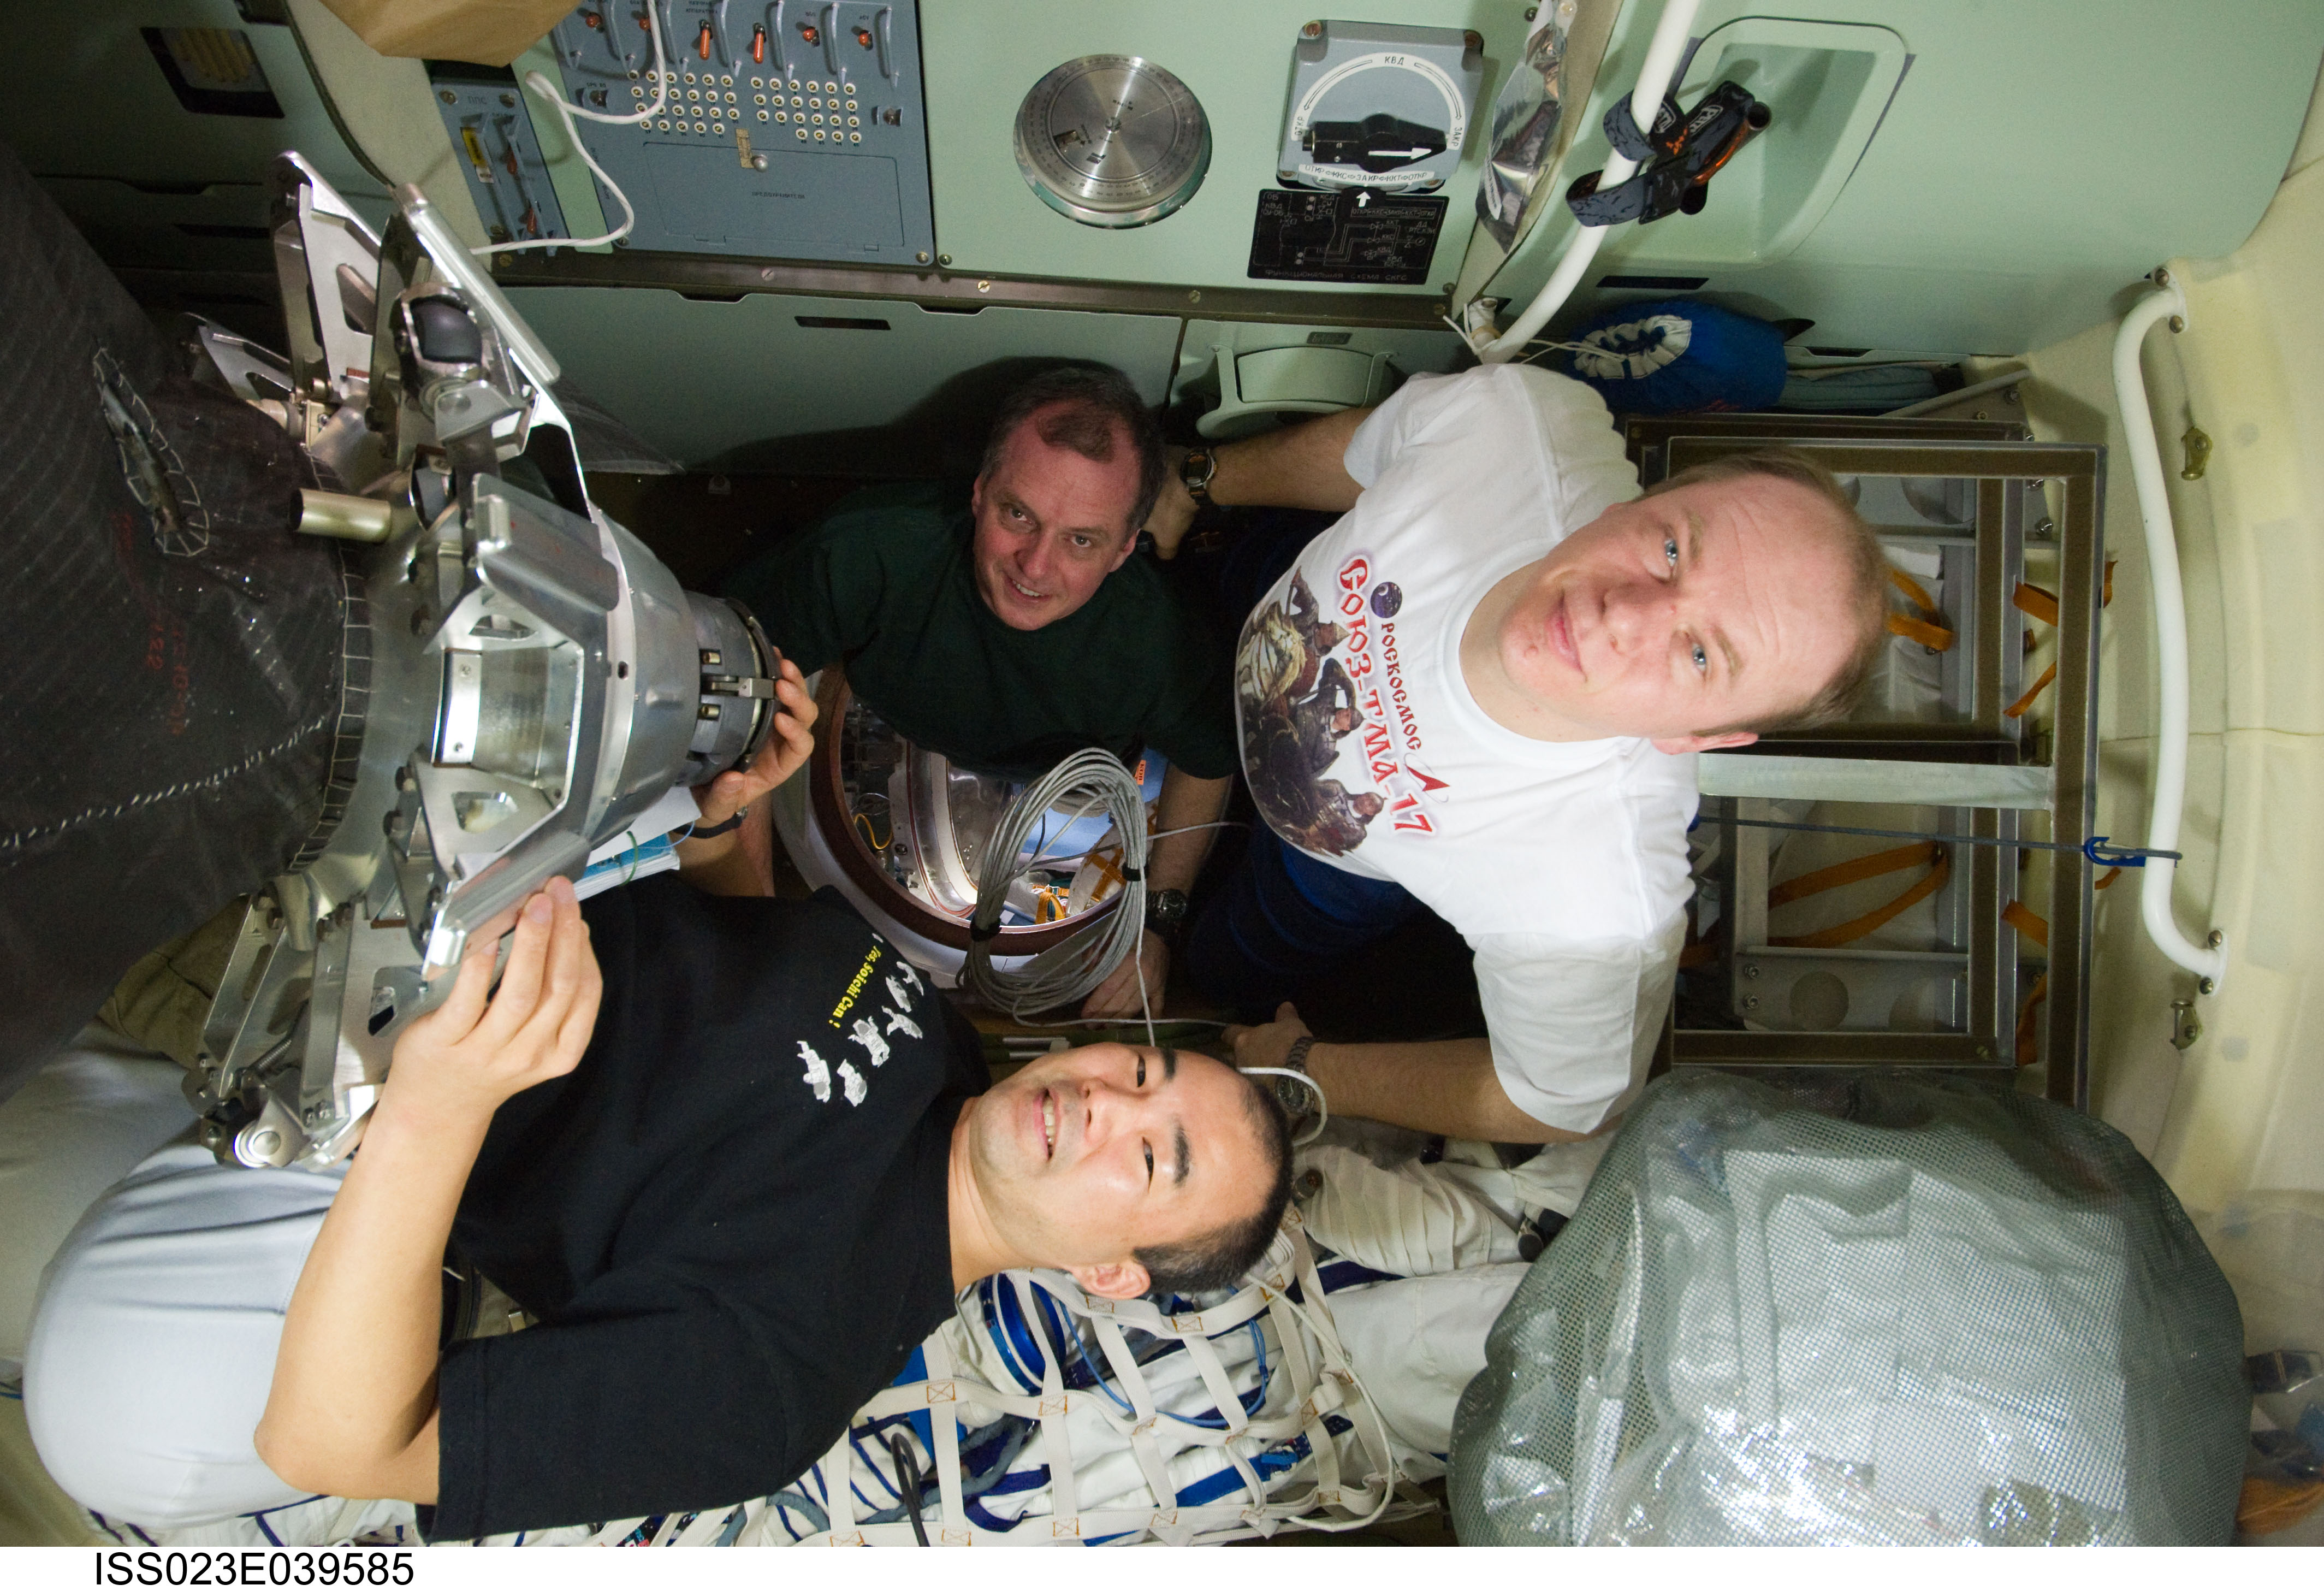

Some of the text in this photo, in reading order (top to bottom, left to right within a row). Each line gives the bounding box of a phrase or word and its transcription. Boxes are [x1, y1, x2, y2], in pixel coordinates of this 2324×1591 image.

[1384, 56, 1404, 66] КВД
[1294, 116, 1304, 137] ОТКР
[1451, 126, 1463, 147] ЗАКР
[1305, 164, 1325, 173] ОТКР
[1356, 173, 1378, 181] ЗАКР
[1385, 173, 1401, 181] ККТ
[1408, 172, 1427, 181] ОТКР
[1265, 270, 1343, 279] ФУНКЦИОНАЛЬНАЯ
[1381, 622, 1422, 750] РОСКОСМОС
[865, 945, 881, 962] Yes,
[833, 996, 853, 1018] Can
